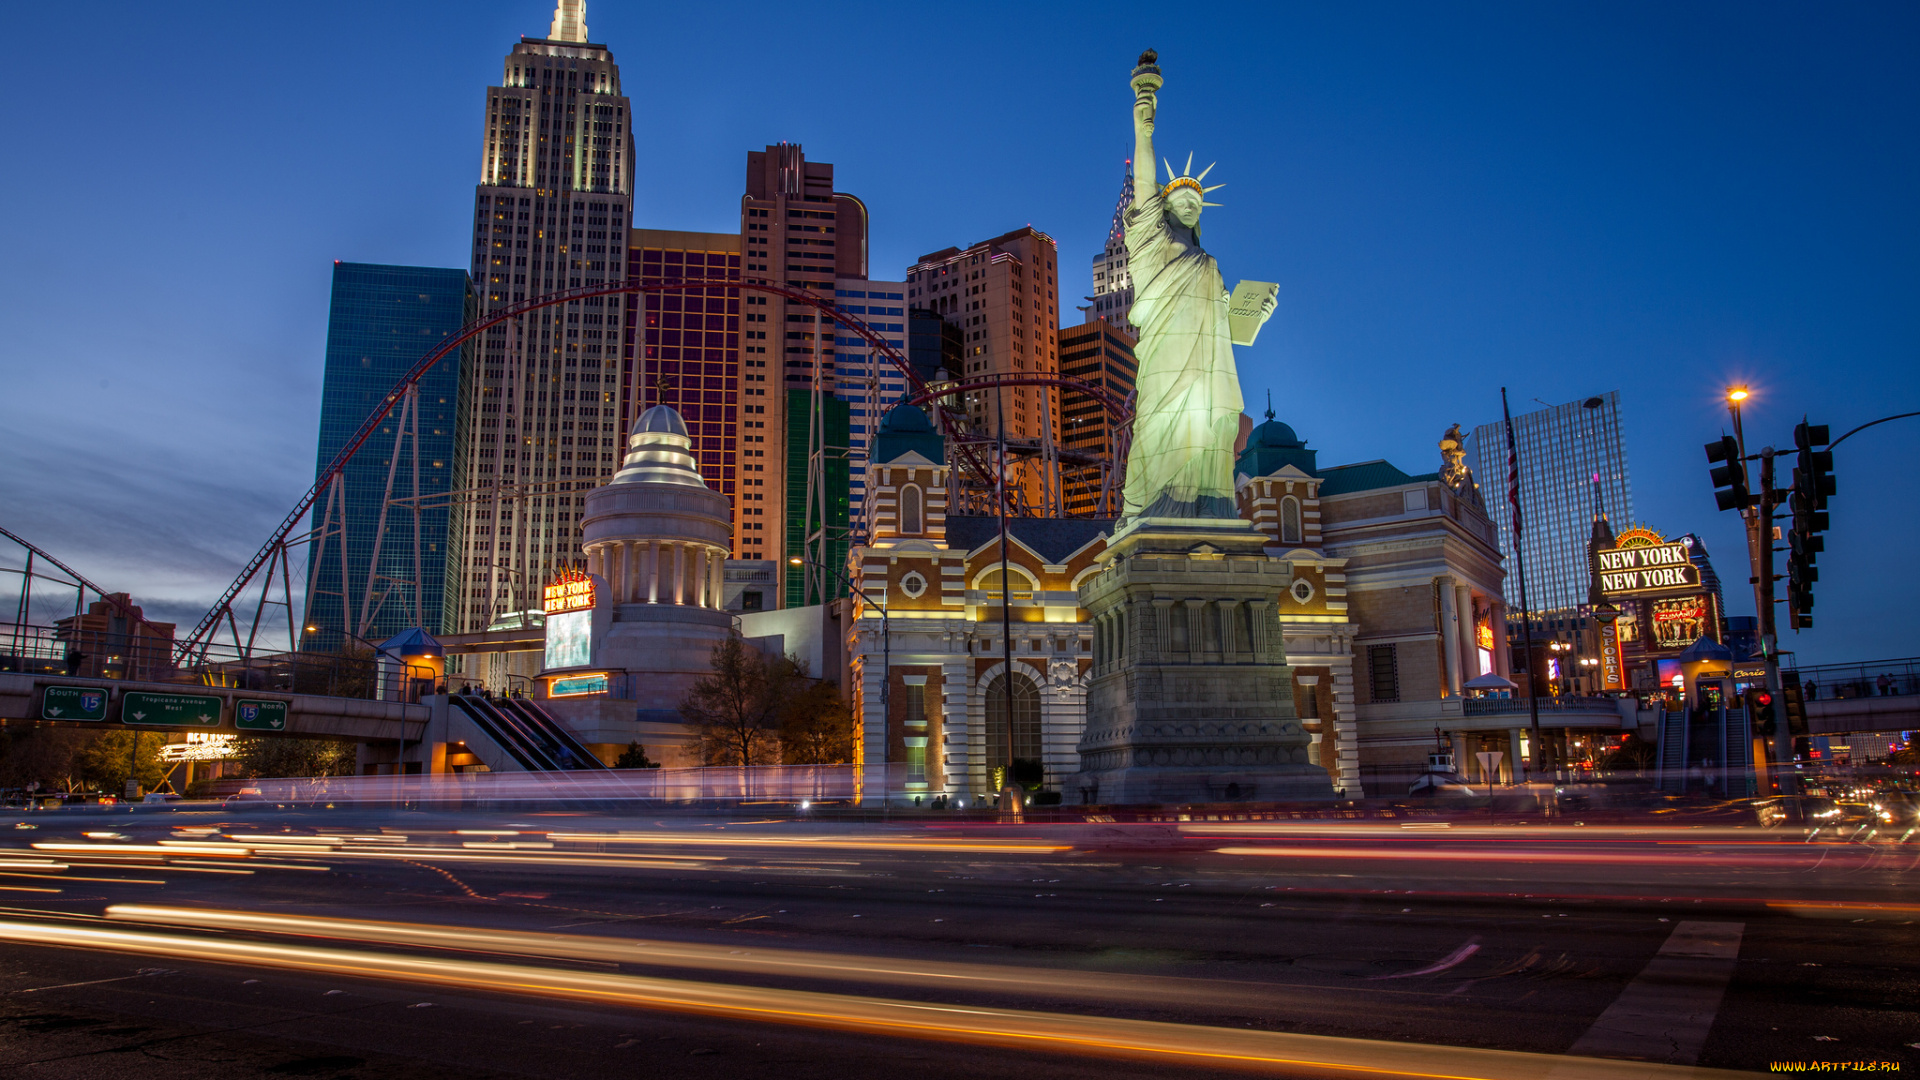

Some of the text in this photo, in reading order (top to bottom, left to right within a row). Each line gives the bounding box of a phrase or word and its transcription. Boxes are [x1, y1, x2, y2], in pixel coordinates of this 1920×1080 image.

[1599, 546, 1685, 570] NEW YORK
[1602, 567, 1688, 591] NEW YORK
[545, 580, 591, 599] NEW YORK
[545, 593, 591, 612] NEW YORK
[1659, 609, 1698, 620] ZUMANITY
[1601, 625, 1619, 683] SPORTS
[49, 689, 79, 697] SOUTH
[141, 696, 178, 704] Tropicana
[84, 697, 99, 709] 15
[244, 708, 256, 718] 15
